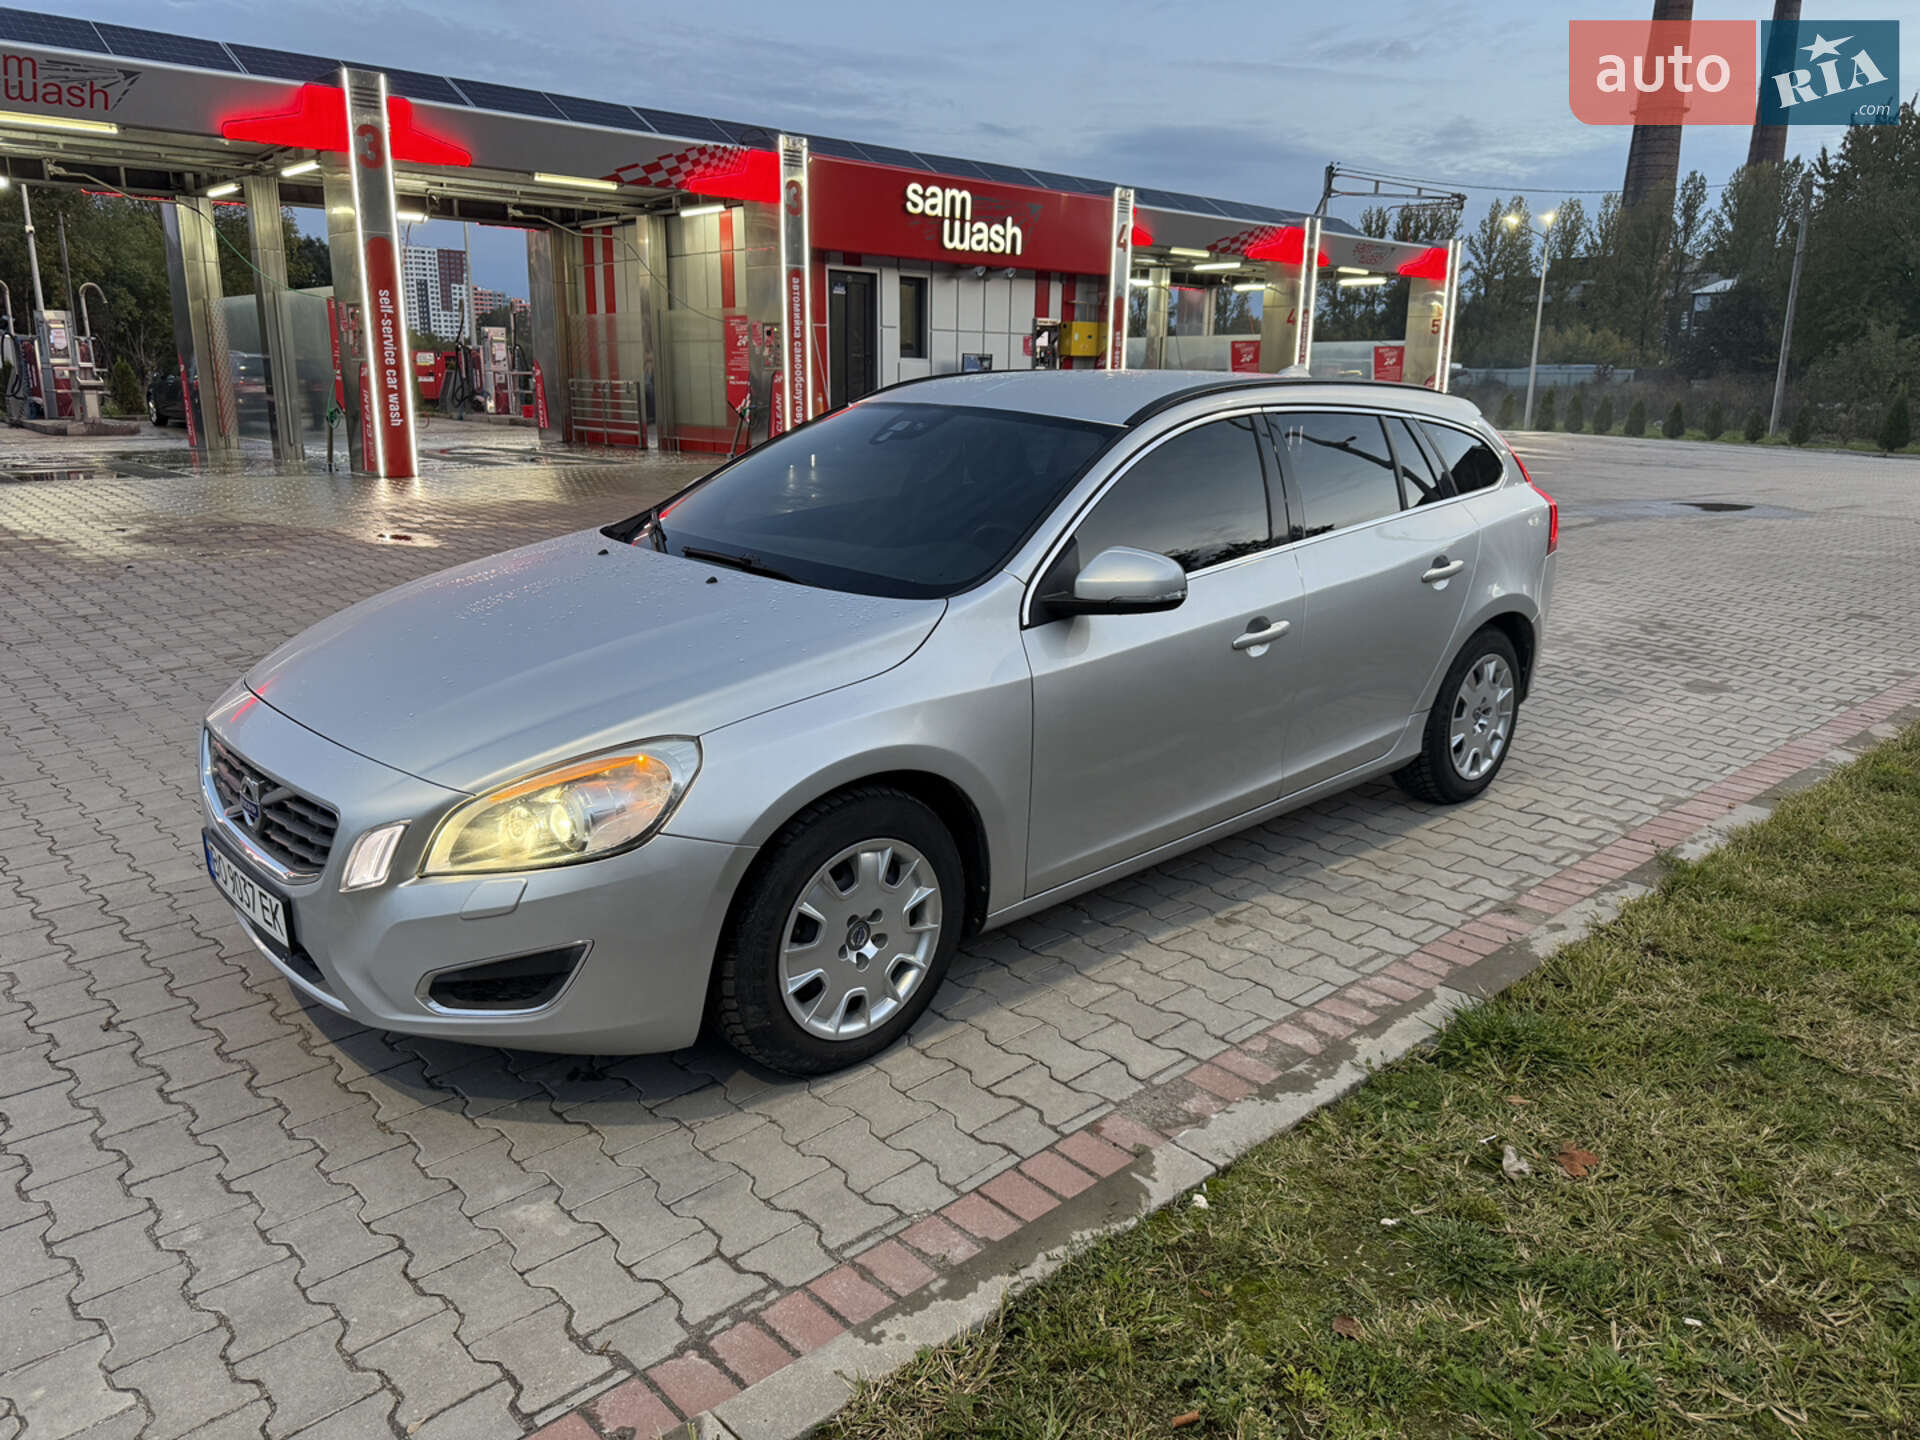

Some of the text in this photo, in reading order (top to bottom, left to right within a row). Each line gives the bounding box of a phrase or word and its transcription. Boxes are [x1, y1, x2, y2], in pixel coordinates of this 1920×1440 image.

[4, 79, 109, 111] wash
[355, 124, 385, 169] 3
[785, 179, 803, 216] 3
[906, 182, 972, 220] sam
[943, 216, 1022, 255] wash
[1117, 223, 1127, 252] 4
[1286, 308, 1297, 326] 4
[1431, 319, 1441, 335] 5
[378, 289, 404, 427] self-service car wash
[227, 863, 256, 914] 9037
[258, 890, 285, 938] EK
